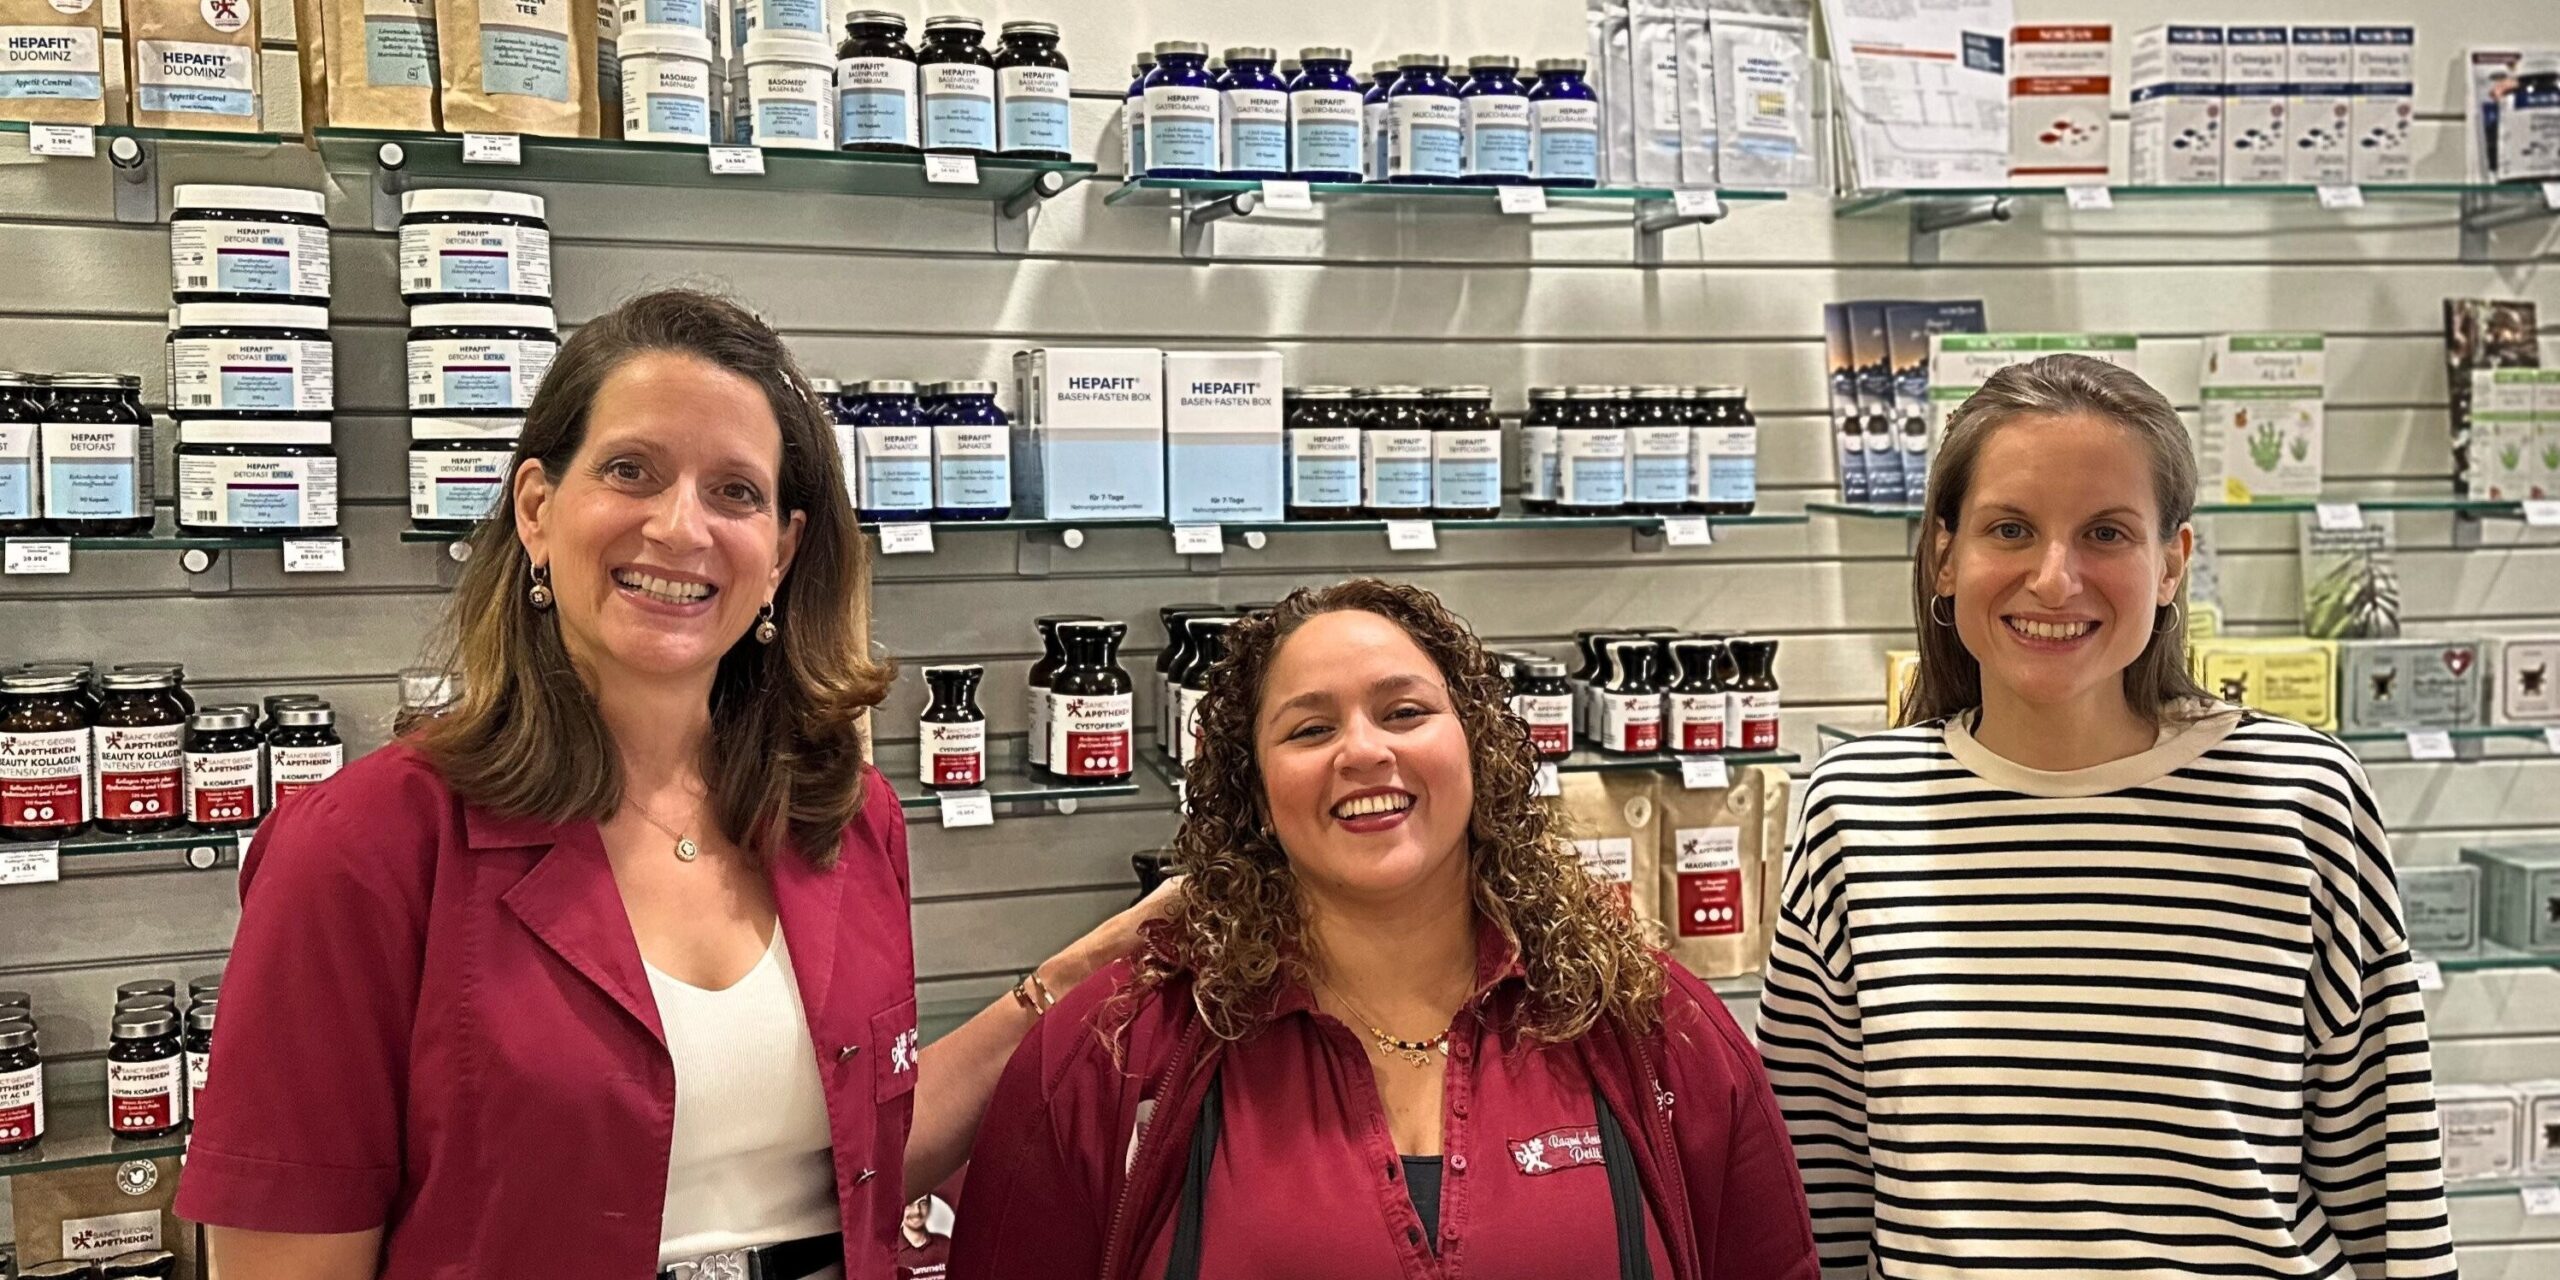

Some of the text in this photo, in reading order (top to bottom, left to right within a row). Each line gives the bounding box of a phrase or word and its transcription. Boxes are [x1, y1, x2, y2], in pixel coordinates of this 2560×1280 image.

[516, 4, 537, 15] TEE
[9, 50, 72, 61] DUOMINZ
[163, 65, 226, 78] DUOMINZ
[1057, 391, 1151, 402] BASEN-FASTEN BOX
[1180, 397, 1272, 406] BASEN-FASTEN BOX
[70, 443, 116, 451] DETOFAST
[1107, 493, 1124, 503] Tage
[124, 739, 178, 749] APOTHEKEN
[18, 745, 76, 756] APOTHEKEN
[101, 749, 182, 760] BEAUTY KOLLAGEN
[31, 755, 81, 767] KOLLAGEN
[148, 759, 182, 768] FORMEL
[286, 758, 331, 766] APOTHEKEN
[42, 765, 80, 775] FORMEL
[208, 763, 253, 772] APOTHEKEN
[122, 1071, 170, 1081] APOTHEKEN
[133, 1085, 168, 1095] KOMPLEX
[93, 1233, 154, 1248] APOTHEKEN
